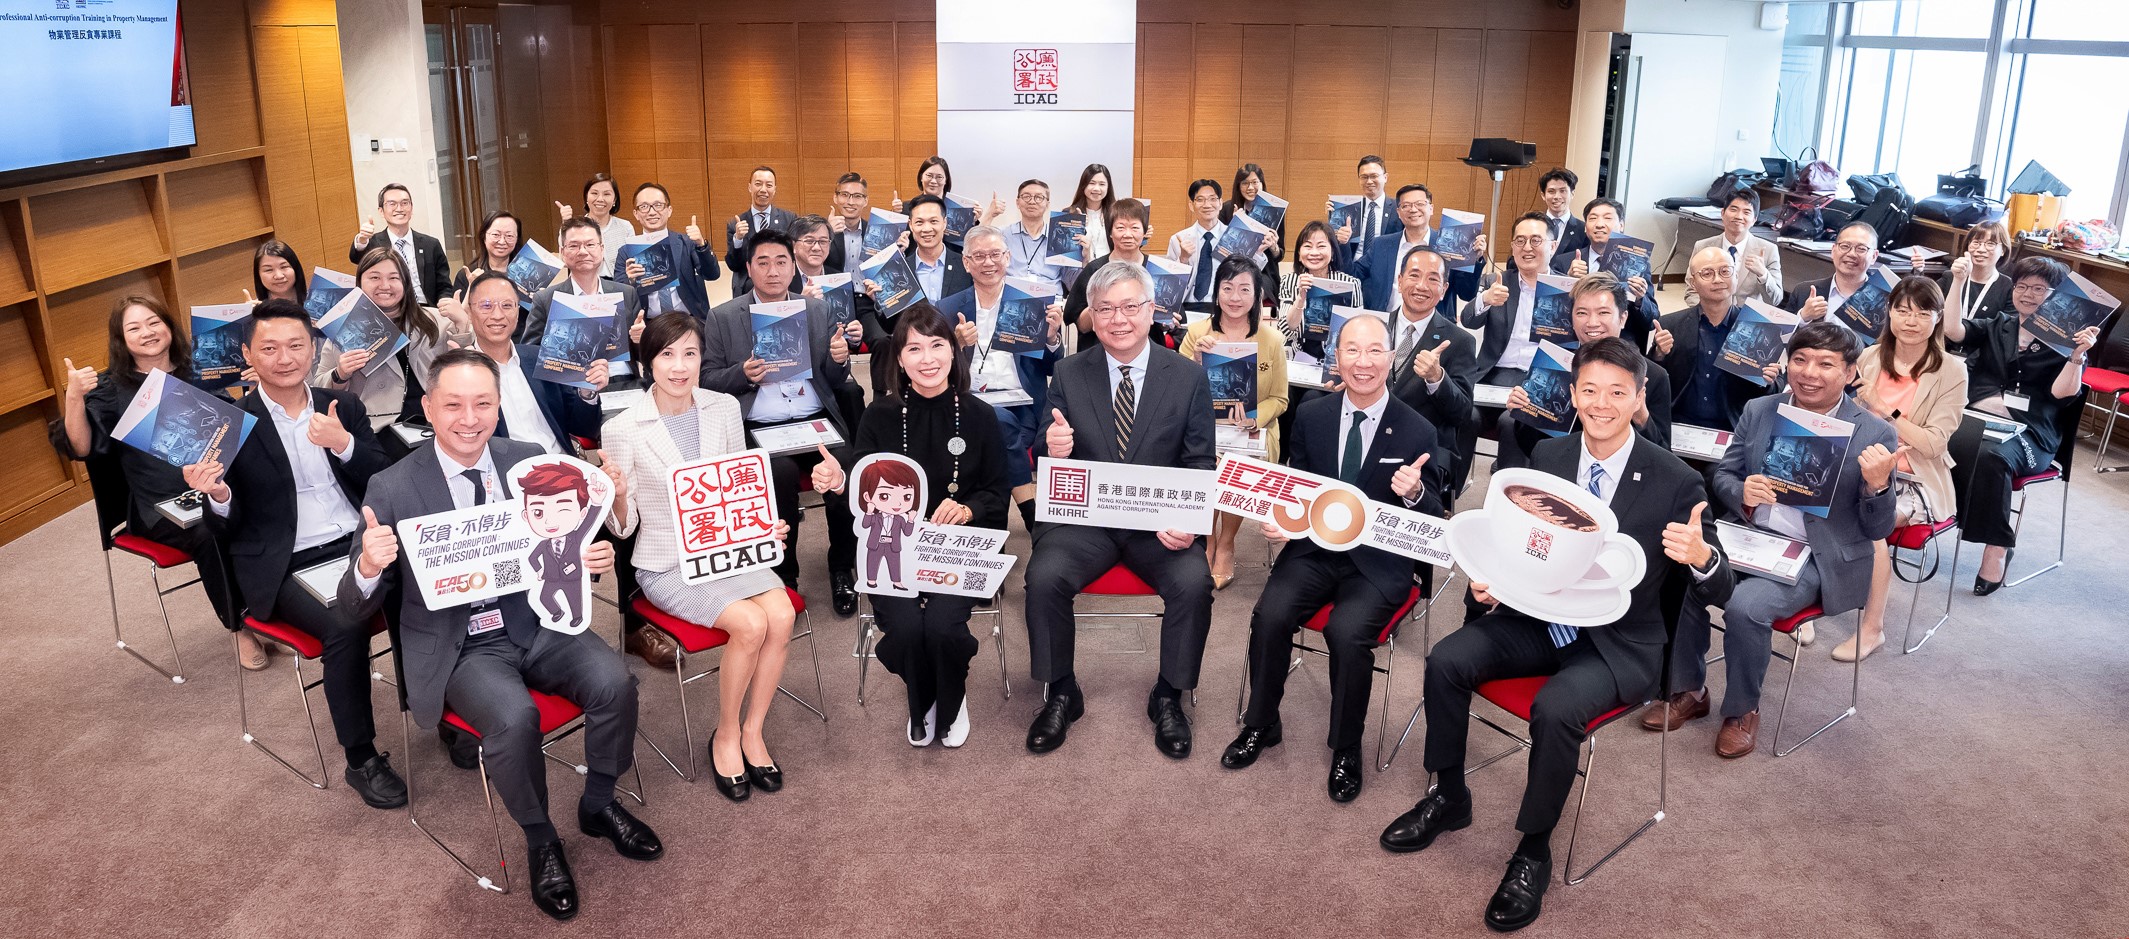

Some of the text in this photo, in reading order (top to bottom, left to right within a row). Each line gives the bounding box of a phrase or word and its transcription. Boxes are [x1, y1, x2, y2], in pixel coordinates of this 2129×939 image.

[0, 13, 33, 21] rofessional
[35, 14, 80, 23] Anti-corruption
[81, 14, 105, 23] Training
[113, 15, 135, 23] Property
[137, 15, 168, 23] Management
[1013, 93, 1058, 105] ICAC
[1097, 483, 1207, 503] 香港國際廉政學院
[1122, 506, 1159, 514] CORRUPTION
[1132, 500, 1176, 509] INTERNATIONAL
[1218, 490, 1272, 516] 廉政公署
[1370, 524, 1395, 537] FIGHTING
[418, 543, 451, 558] FIGHTING
[425, 537, 530, 569] THE MISSION CONTINUES
[914, 545, 942, 555] FIGHTING
[1373, 533, 1451, 562] THE MISSION CONTINUES
[1525, 547, 1548, 561] ICAC
[686, 540, 778, 580] ICAC
[917, 553, 1005, 570] THE MISSION CONTINUES
